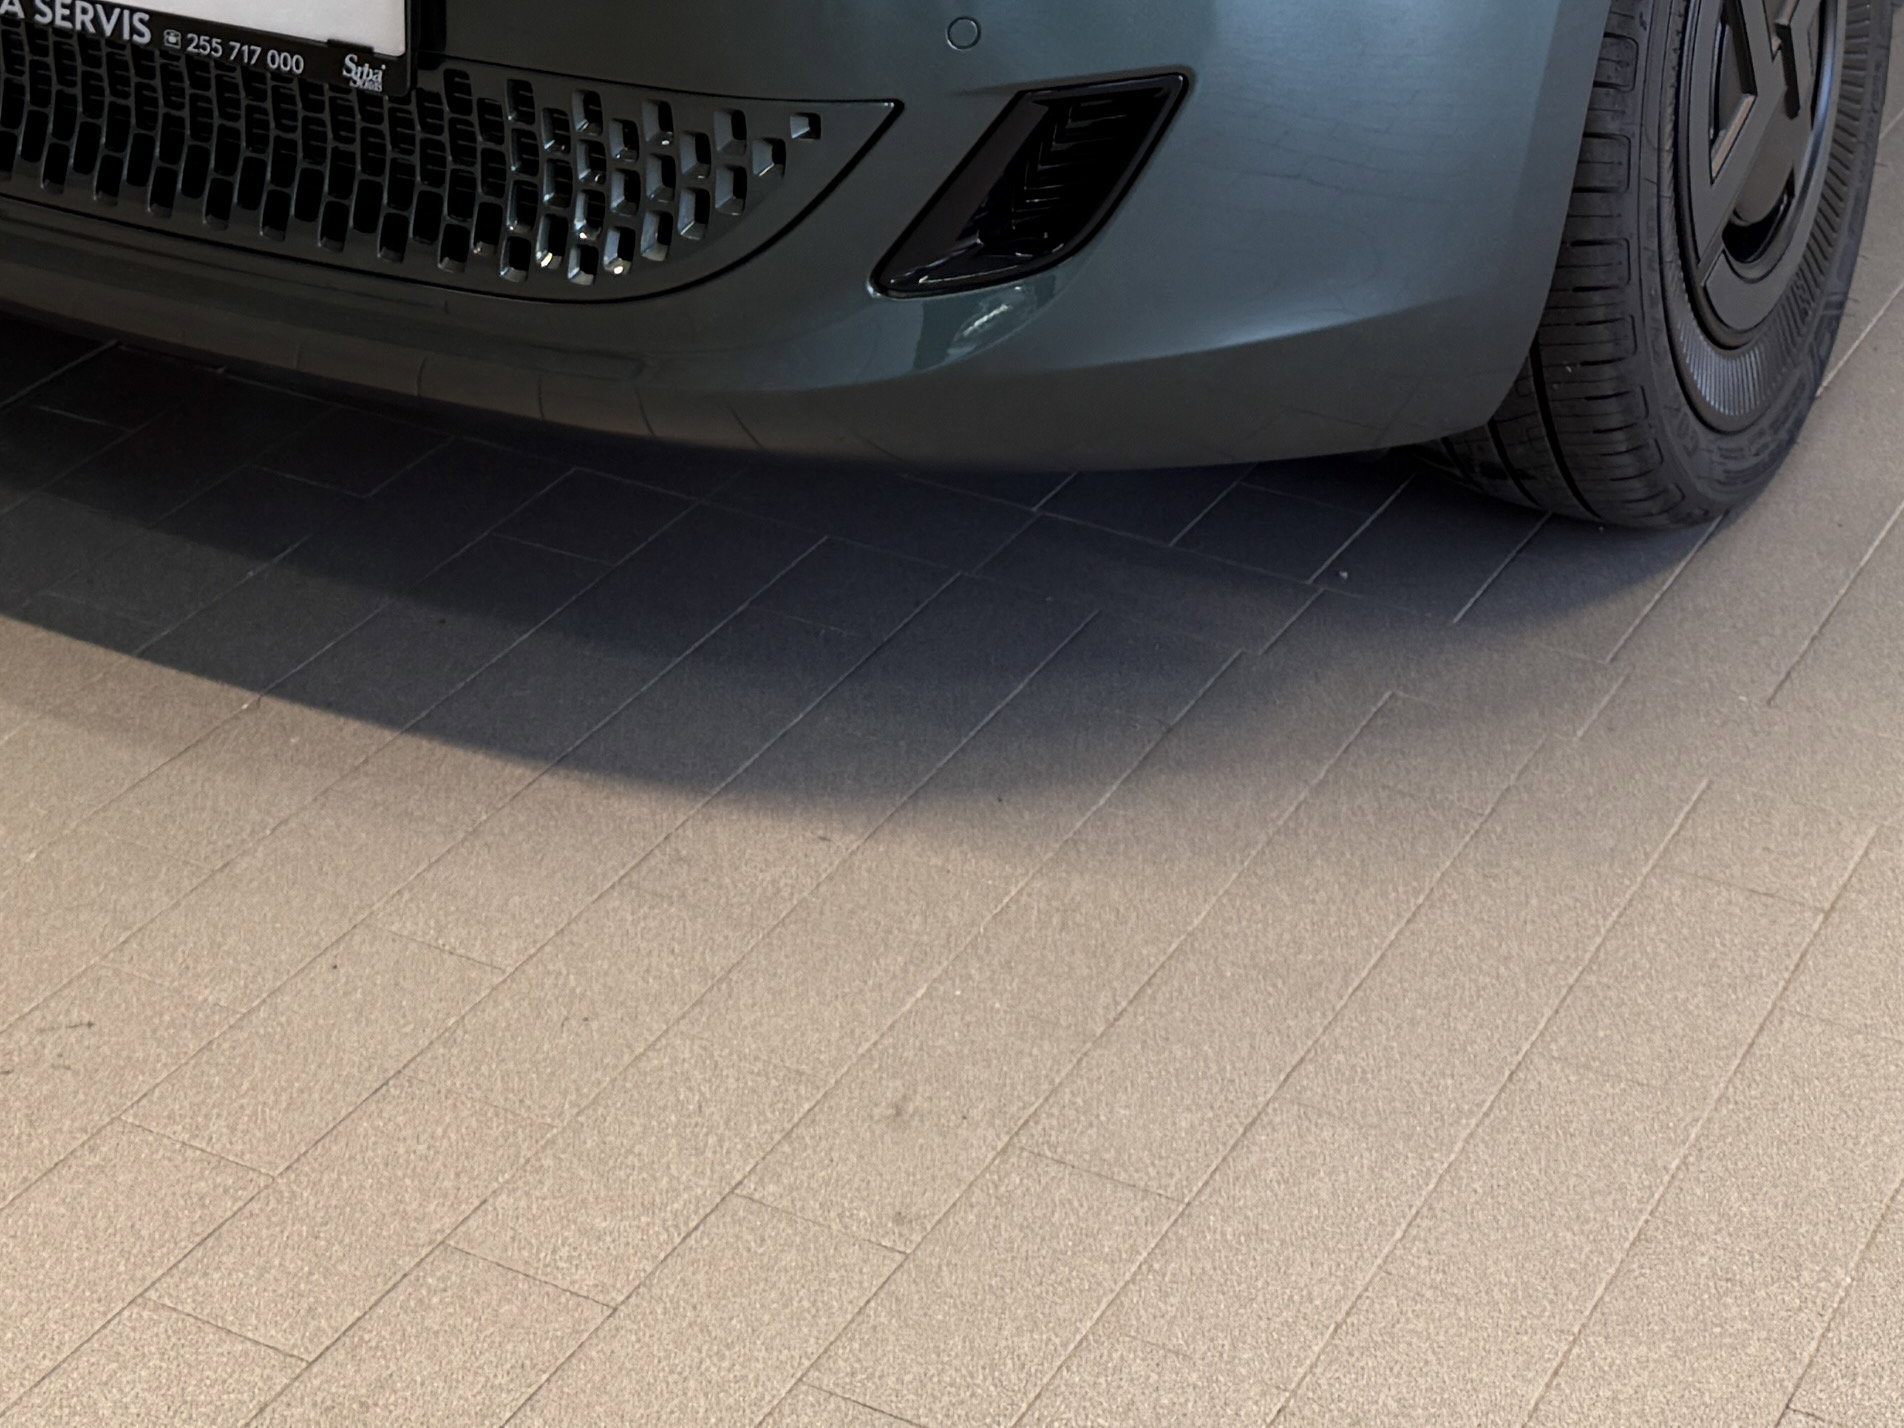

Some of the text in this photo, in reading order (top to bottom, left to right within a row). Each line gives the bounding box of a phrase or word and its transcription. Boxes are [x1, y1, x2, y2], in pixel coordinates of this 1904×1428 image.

[186, 32, 223, 58] 255
[228, 41, 262, 66] 717
[267, 49, 305, 75] 000
